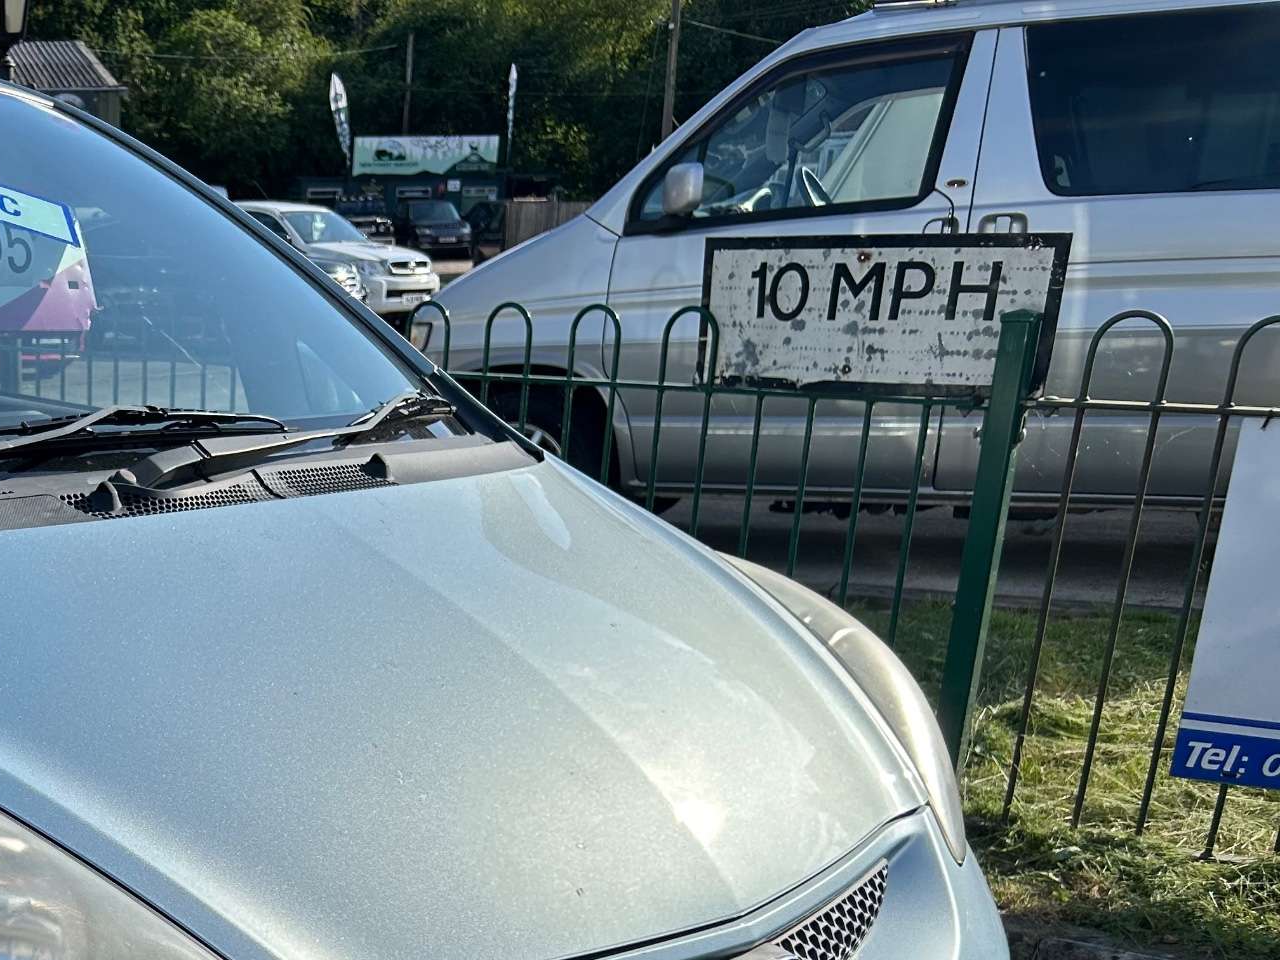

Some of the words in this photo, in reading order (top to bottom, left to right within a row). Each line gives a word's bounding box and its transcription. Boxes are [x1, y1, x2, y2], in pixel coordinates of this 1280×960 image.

[751, 261, 810, 322] 10
[826, 260, 1004, 322] MPH
[1185, 741, 1249, 774] Tel:
